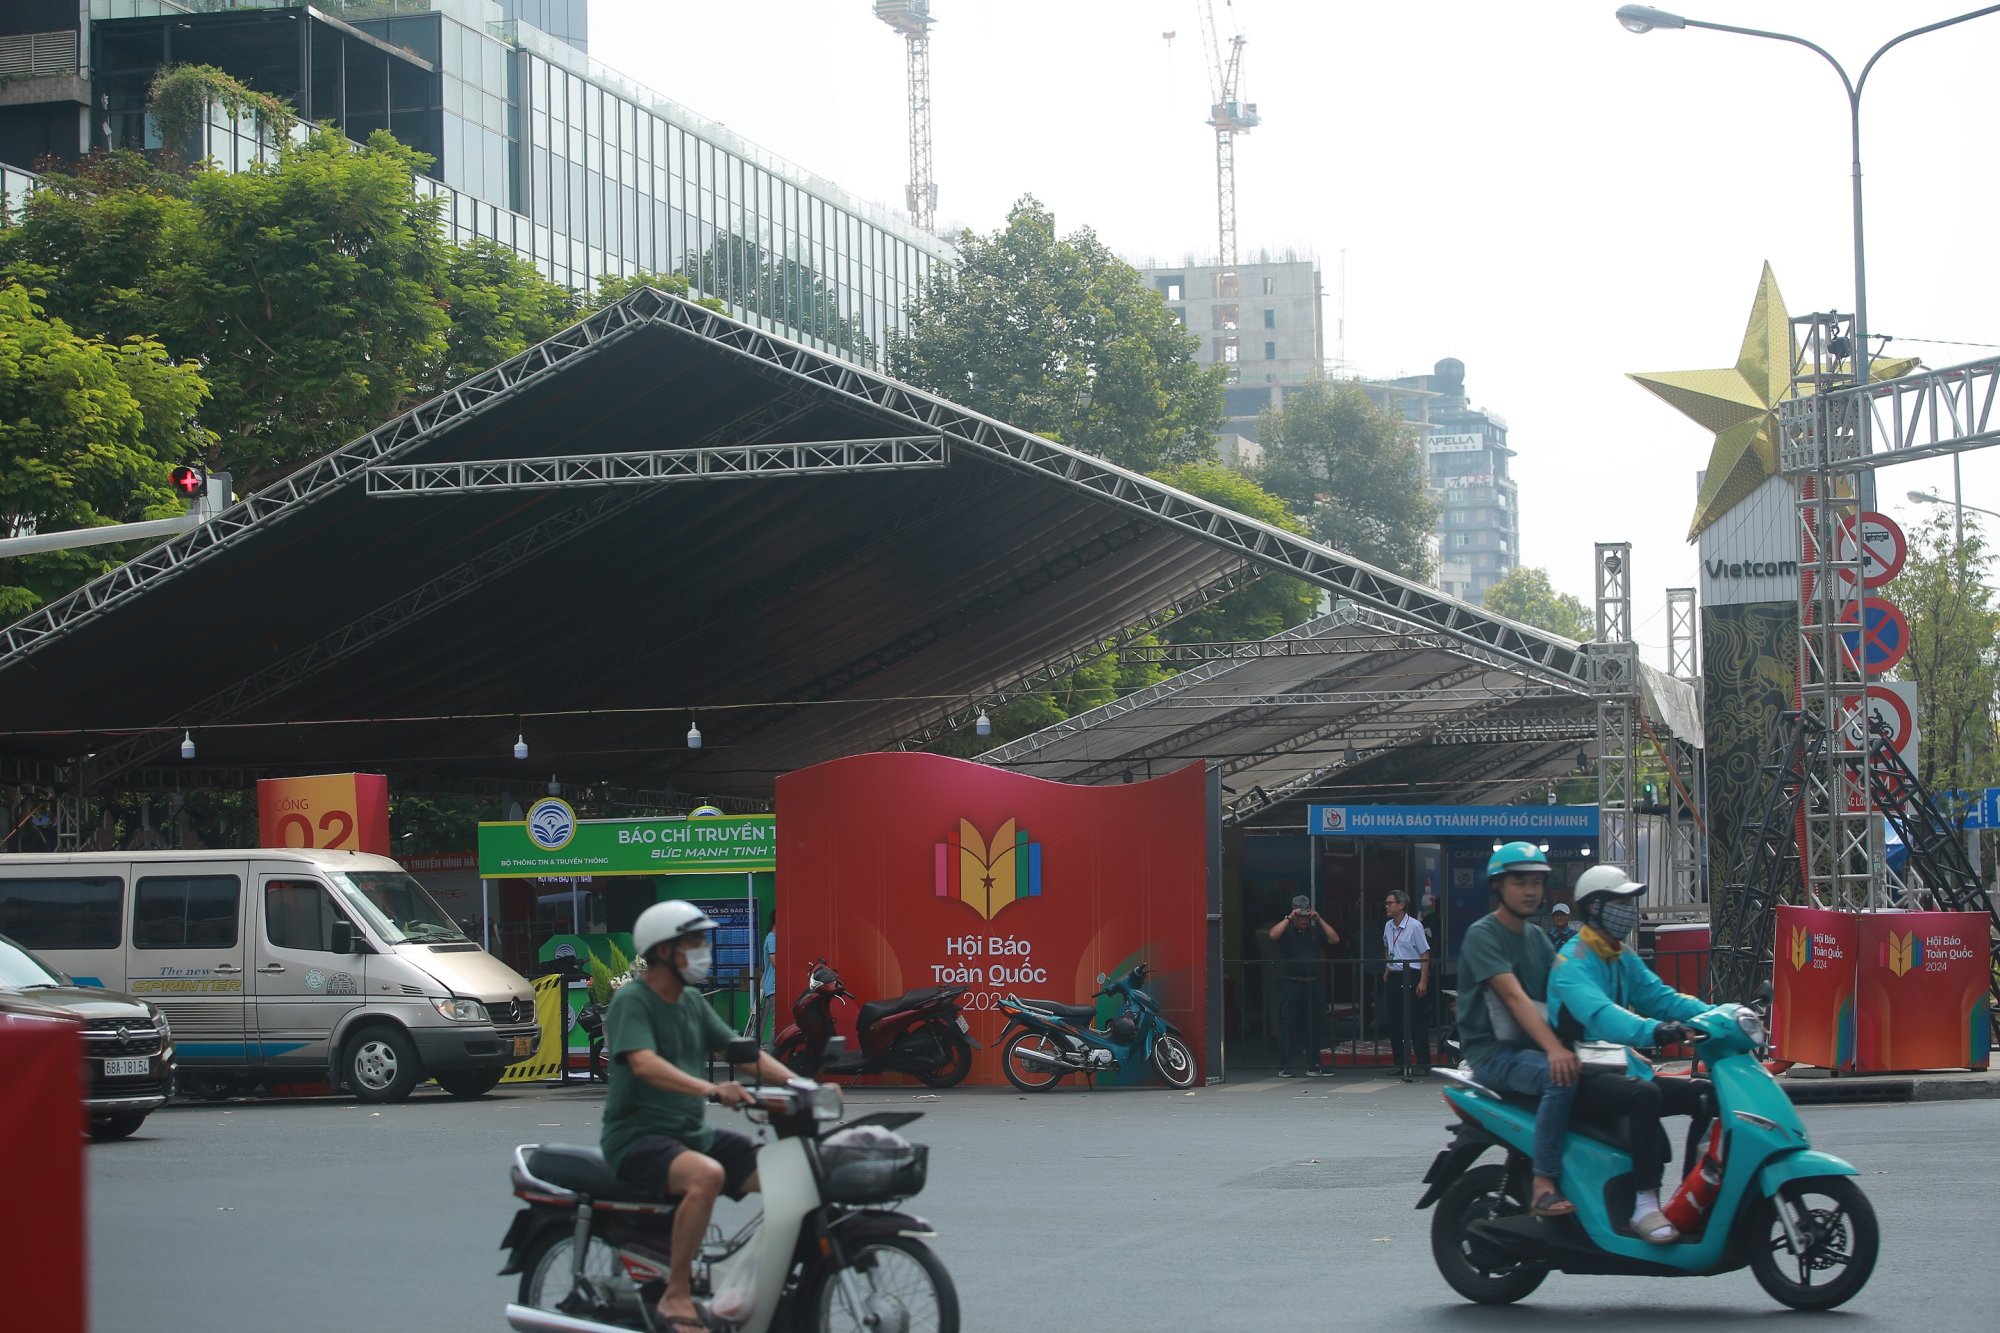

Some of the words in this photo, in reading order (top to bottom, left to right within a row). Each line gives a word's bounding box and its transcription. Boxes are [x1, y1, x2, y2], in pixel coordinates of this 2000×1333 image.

[1428, 436, 1475, 445] APELLA
[1705, 560, 1797, 578] Vietcom
[1352, 813, 1374, 828] HỘI
[1376, 812, 1404, 826] NHÀ
[1406, 812, 1432, 826] BÁO
[1434, 812, 1479, 826] THÀNH
[1481, 811, 1508, 826] PHỐ
[1530, 812, 1552, 826] CHÍ
[1554, 815, 1589, 827] MINH
[277, 810, 353, 849] 02
[618, 826, 656, 844] BÁO
[660, 825, 691, 843] CHÍ
[695, 822, 765, 842] TRUYỀN
[651, 846, 682, 858] SỨC
[684, 847, 729, 860] MẠNH
[732, 847, 768, 856] TINH
[501, 859, 511, 867] BỘ
[512, 858, 537, 866] THÔNG
[537, 858, 549, 866] TIN
[556, 857, 583, 865] TRUYỀN
[1813, 933, 1824, 945] Hội
[1825, 934, 1836, 944] Báo
[1926, 936, 1941, 948] Hội
[1943, 935, 1961, 946] Báo
[947, 934, 982, 960] Hội
[988, 934, 1031, 955] Báo
[1813, 946, 1828, 956] Toàn
[1828, 945, 1843, 959] Quốc
[1925, 949, 1948, 959] Toàn
[1949, 945, 1974, 960] Quốc
[160, 967, 182, 976] The
[186, 968, 212, 976] new
[930, 962, 983, 983] Toàn
[988, 957, 1047, 986] Quốc
[1813, 959, 1827, 970] 2024
[1925, 961, 1947, 972] 2024
[132, 980, 242, 992] SPRINTER
[963, 992, 1003, 1011] 202
